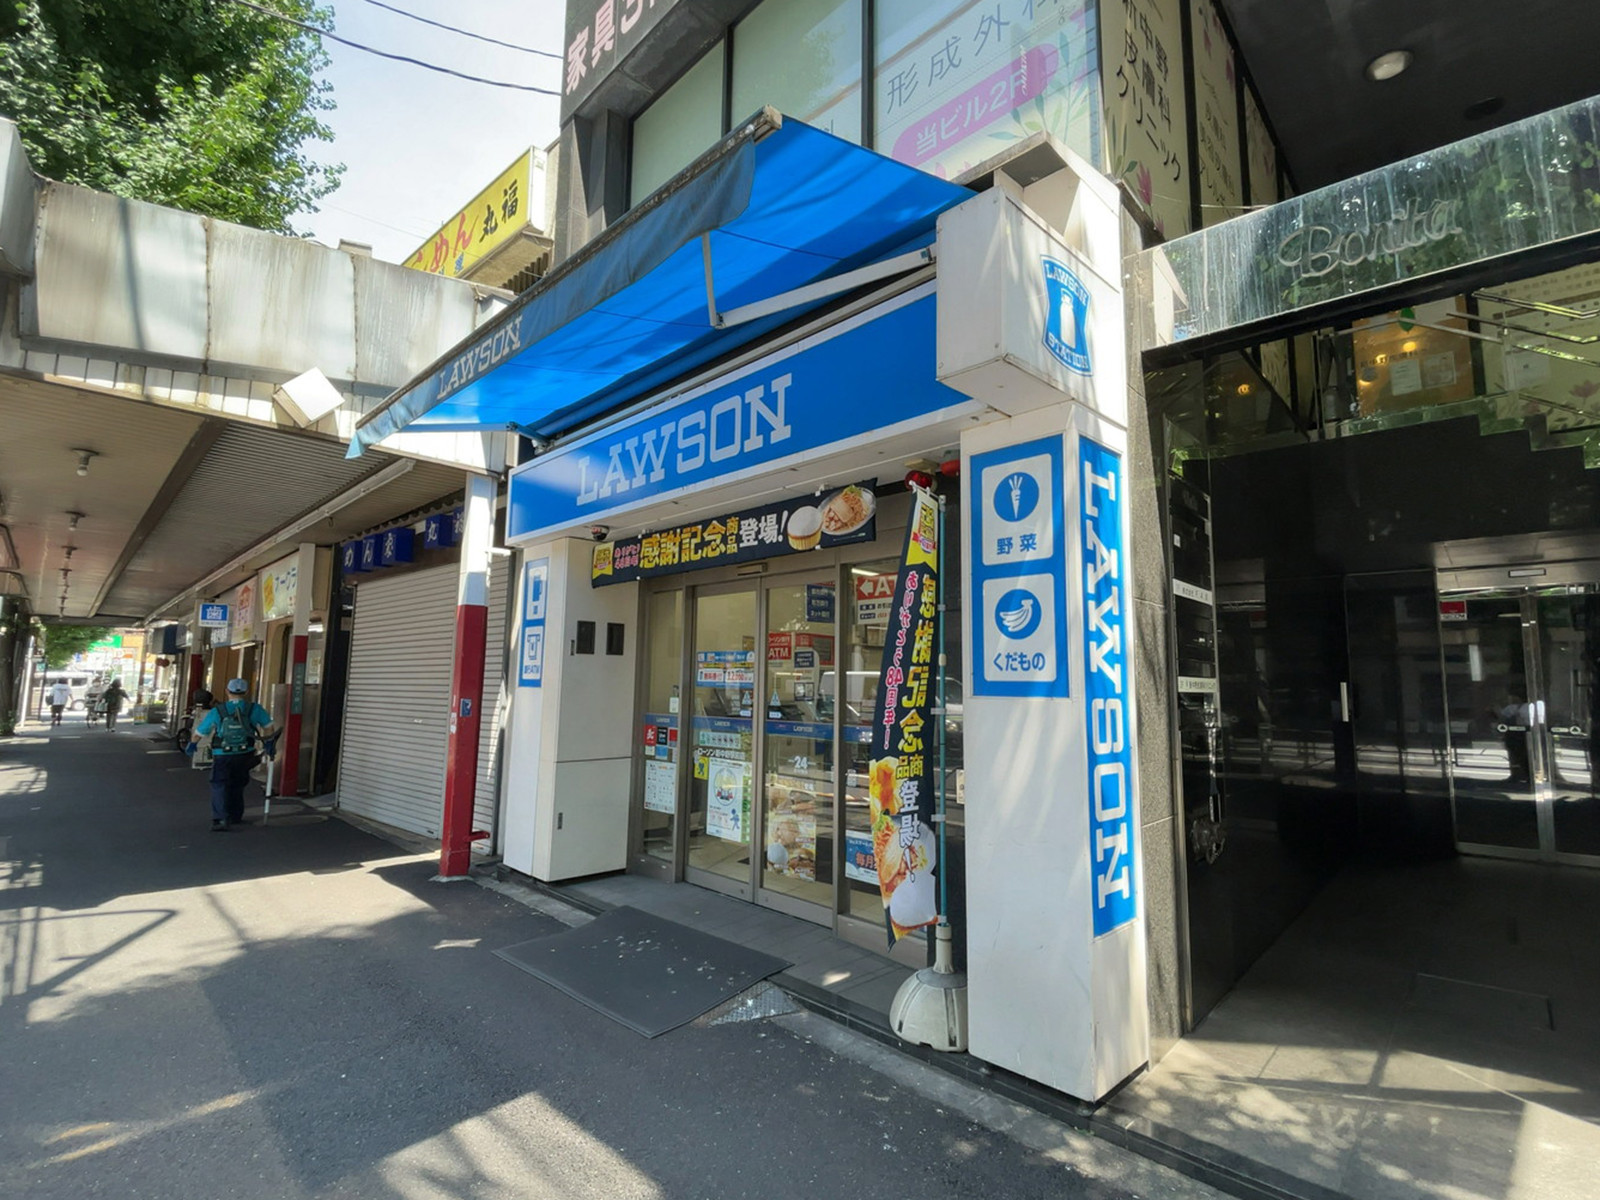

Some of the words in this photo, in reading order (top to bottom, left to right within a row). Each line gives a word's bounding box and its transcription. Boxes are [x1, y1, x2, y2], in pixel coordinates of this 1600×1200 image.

[915, 71, 1024, 157] 当ビル2F
[1116, 65, 1181, 182] クリニック
[479, 178, 519, 244] 丸福
[1045, 263, 1088, 306] LAWSON
[436, 314, 523, 400] LAWSON
[576, 372, 792, 507] LAWSON
[996, 532, 1037, 556] 野菜
[768, 647, 789, 658] ATM
[992, 652, 1046, 672] くだもの
[1084, 460, 1130, 910] LAWSON
[794, 755, 808, 769] 24
